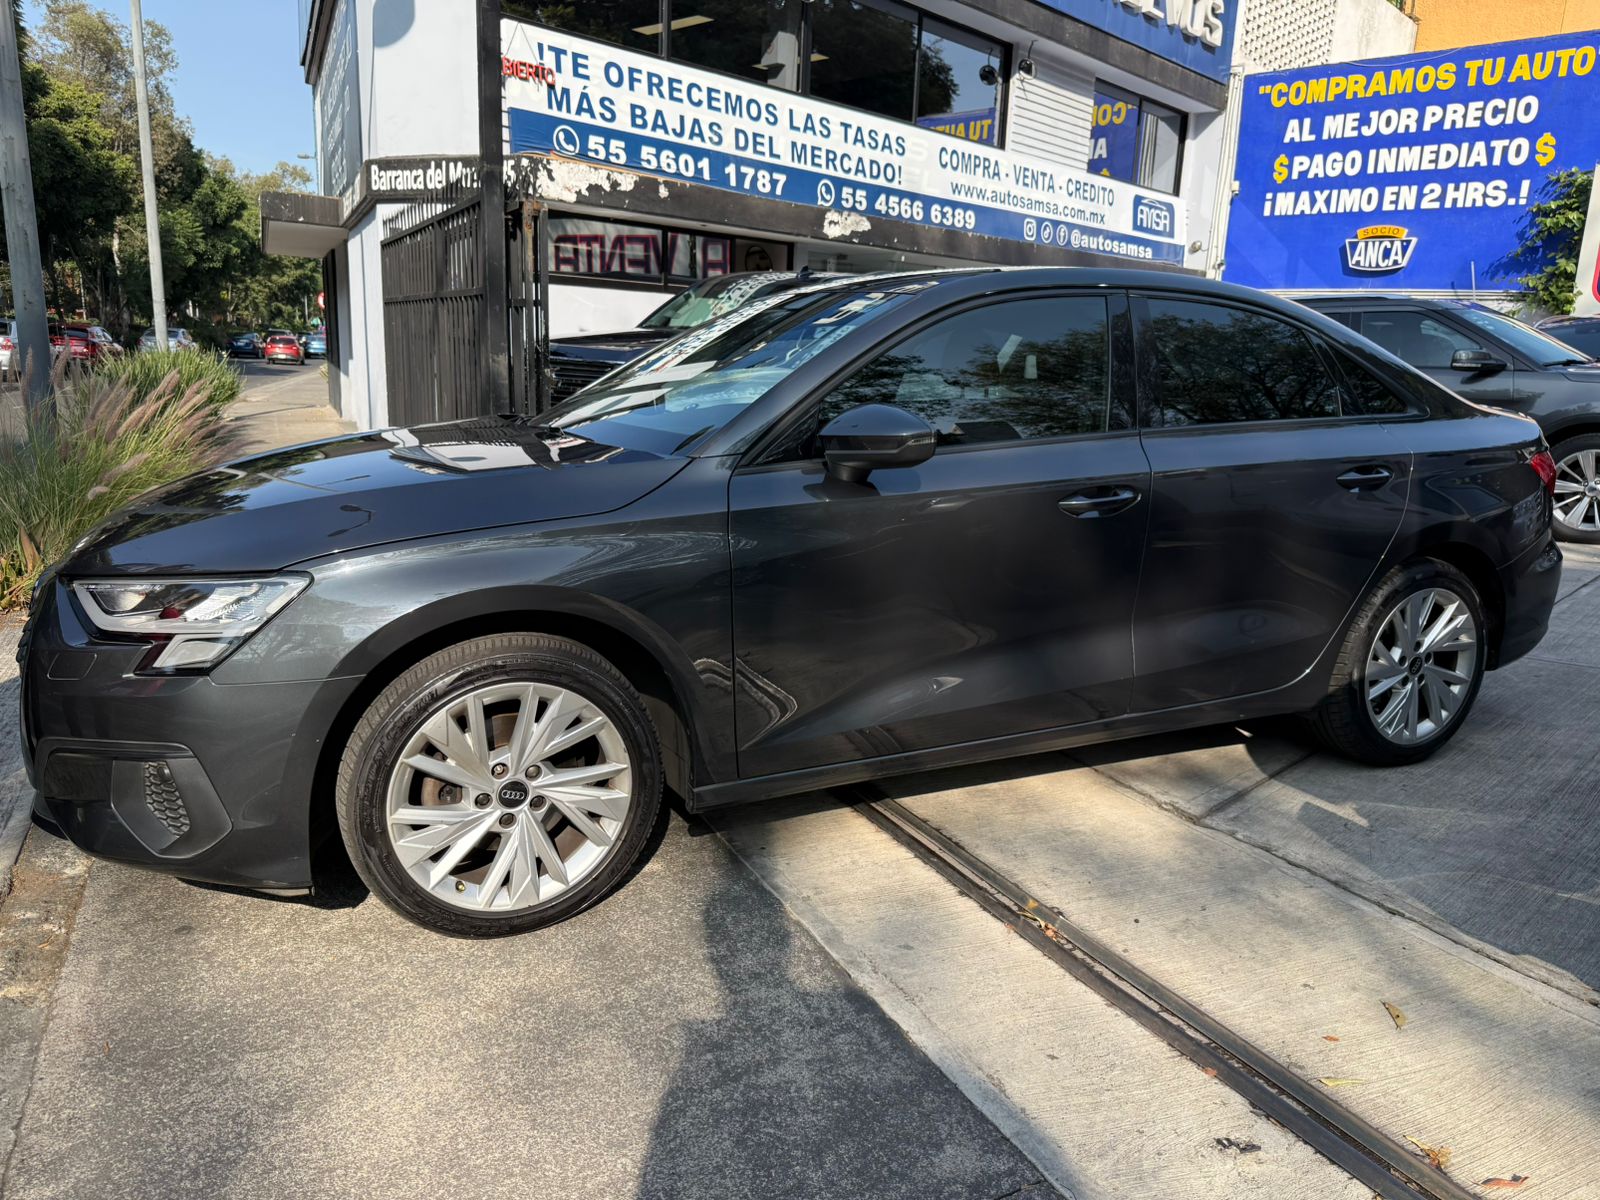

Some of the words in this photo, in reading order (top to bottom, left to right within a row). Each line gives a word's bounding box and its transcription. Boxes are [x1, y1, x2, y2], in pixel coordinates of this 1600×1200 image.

[501, 56, 556, 86] BIERTO
[1464, 58, 1504, 87] TU
[604, 62, 778, 126] OFRECEMOS
[788, 108, 830, 138] LAS
[840, 122, 906, 156] TASAS
[1283, 118, 1316, 144] AL
[1322, 106, 1418, 140] MEJOR
[1422, 95, 1540, 132] PRECIO
[546, 86, 616, 123] MÁS
[630, 102, 723, 146] BAJAS
[734, 128, 781, 160] DEL
[790, 140, 902, 186] MERCADO!
[587, 134, 627, 165] 55
[640, 146, 711, 181] 5601
[724, 162, 786, 196] 1787
[1366, 137, 1530, 174] INMEDIATO
[371, 164, 424, 190] Barranca
[426, 160, 446, 190] del
[938, 146, 1001, 181] COMPRA
[1013, 164, 1056, 194] VENTA
[1066, 177, 1115, 208] CREDITO
[841, 186, 867, 212] 55
[874, 193, 924, 221] 4566
[930, 203, 976, 229] 6389
[950, 180, 1106, 226] www.autosamsa.com.mx
[1263, 187, 1378, 216] ¡MAXIMO
[1382, 184, 1417, 212] EN
[1420, 183, 1442, 210] 2
[1444, 179, 1532, 208] HRS.!
[1070, 229, 1152, 259] @autosamsa
[1363, 226, 1400, 236] SOCIO
[1352, 240, 1403, 268] ANCA
